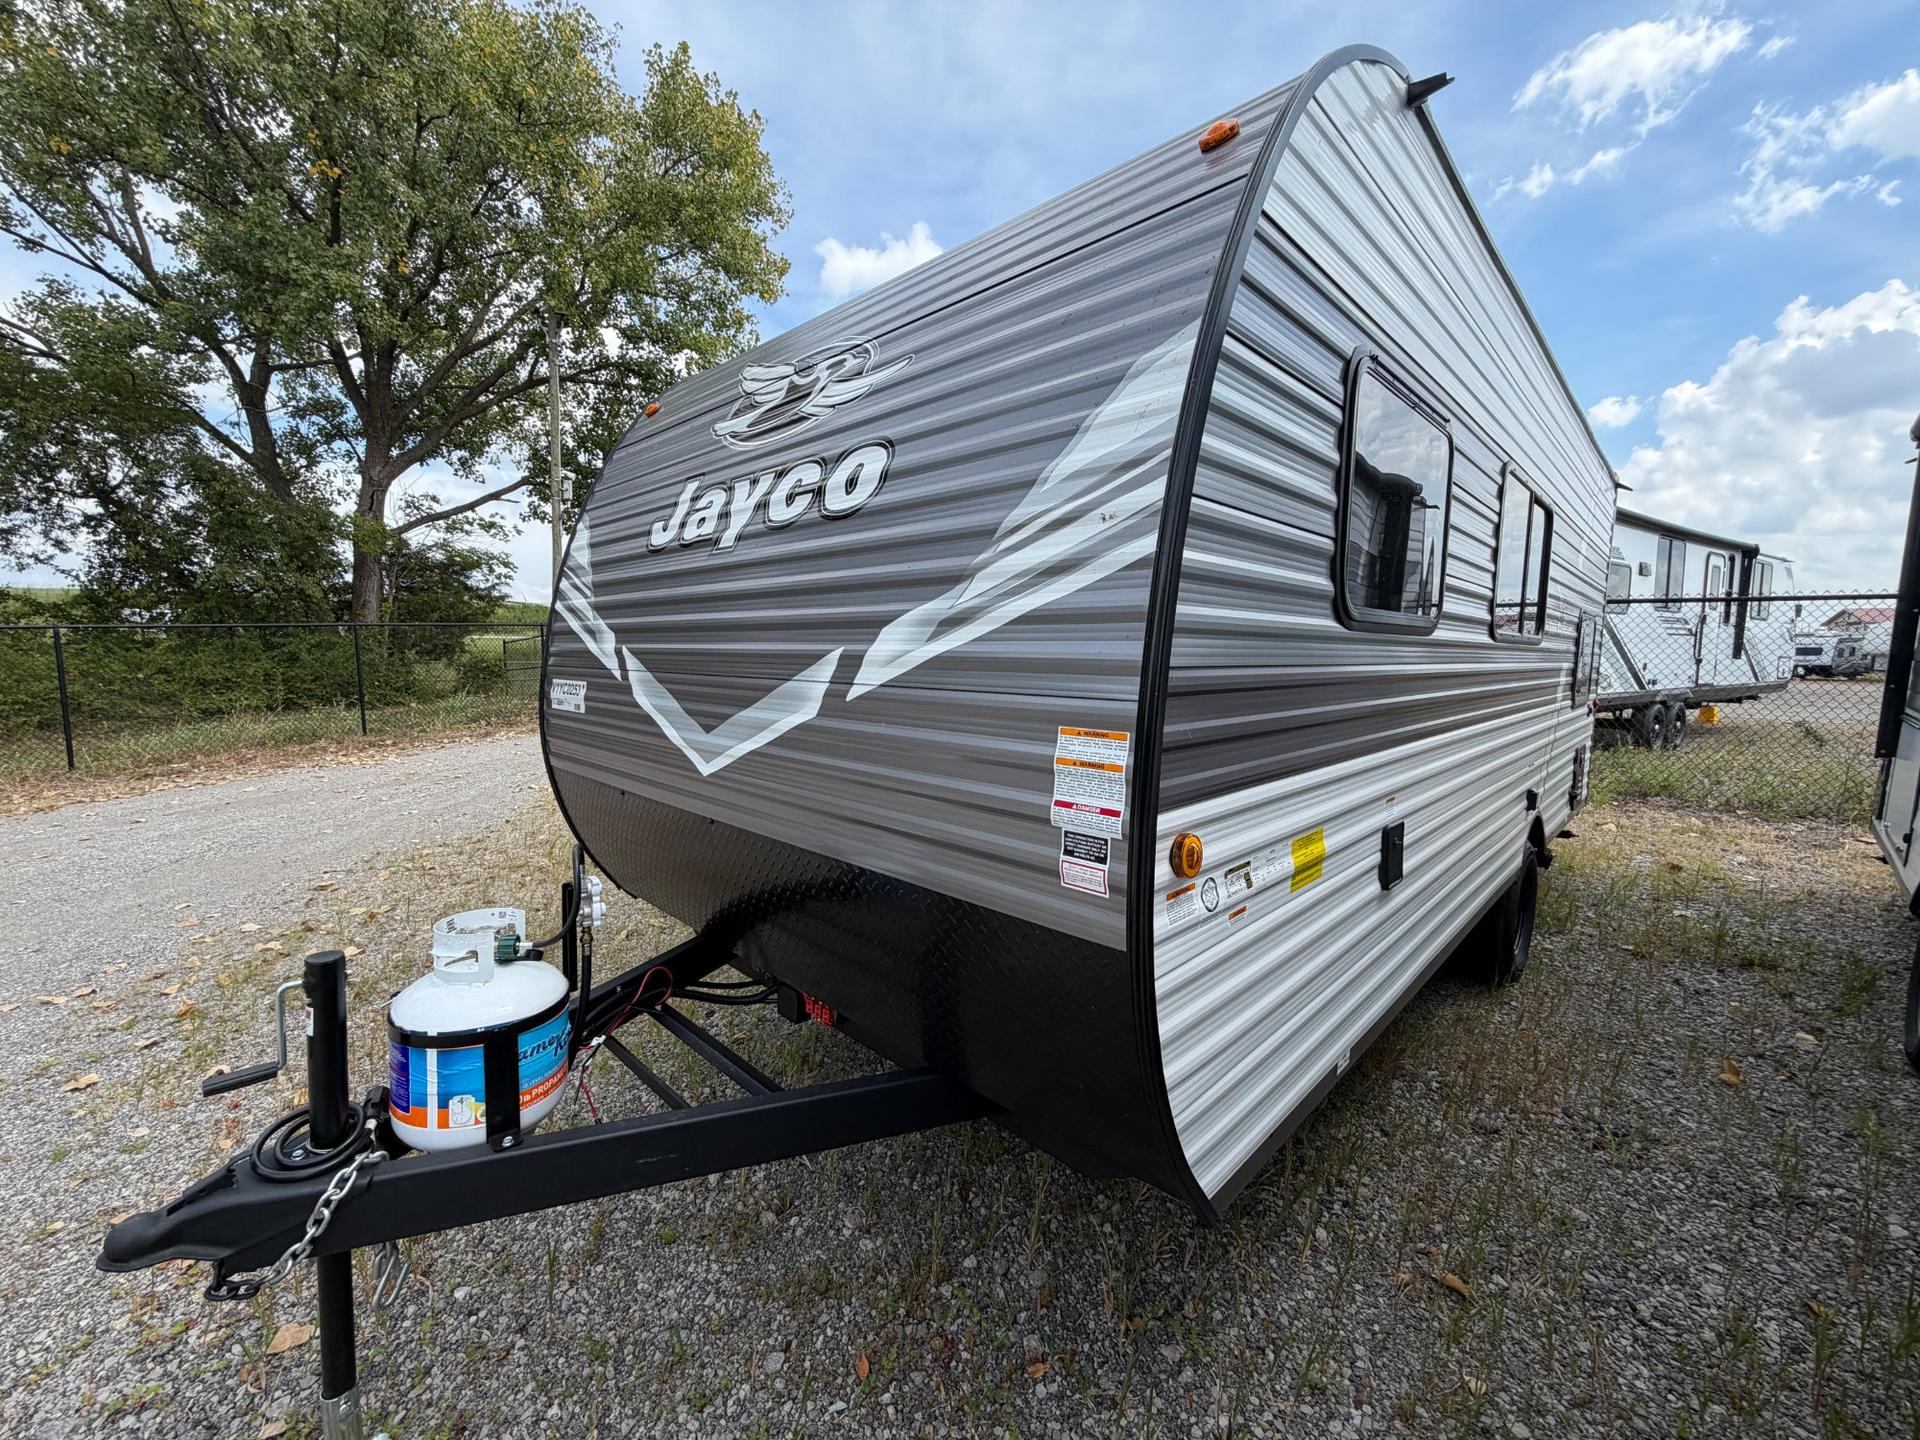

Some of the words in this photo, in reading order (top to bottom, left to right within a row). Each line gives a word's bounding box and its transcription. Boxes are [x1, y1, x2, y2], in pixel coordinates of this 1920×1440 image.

[648, 437, 894, 553] Jayco
[1080, 761, 1104, 769] WARNING
[1078, 805, 1101, 813] DANGER
